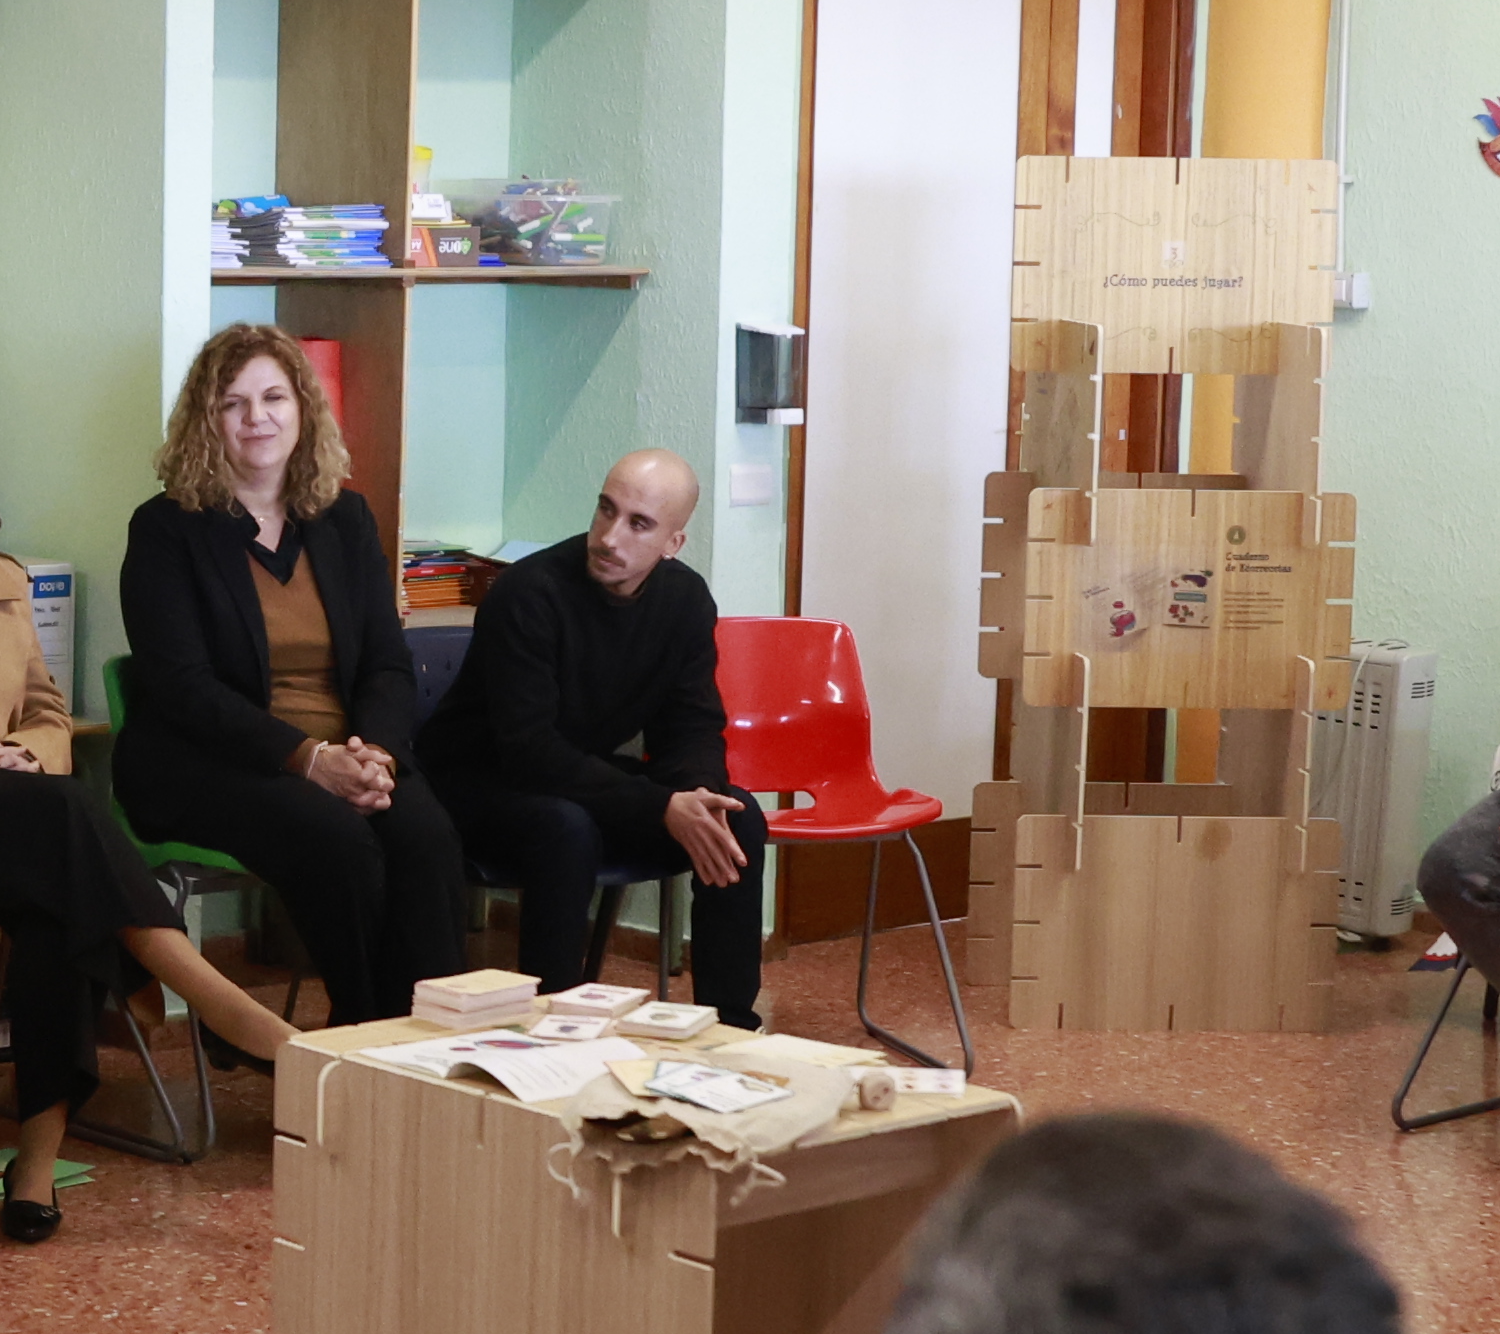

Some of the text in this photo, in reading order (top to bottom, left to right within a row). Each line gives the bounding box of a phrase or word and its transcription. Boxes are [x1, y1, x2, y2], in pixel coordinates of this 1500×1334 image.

[1171, 247, 1178, 260] 3
[1103, 274, 1244, 289] ¿Cómo puedes jugar?
